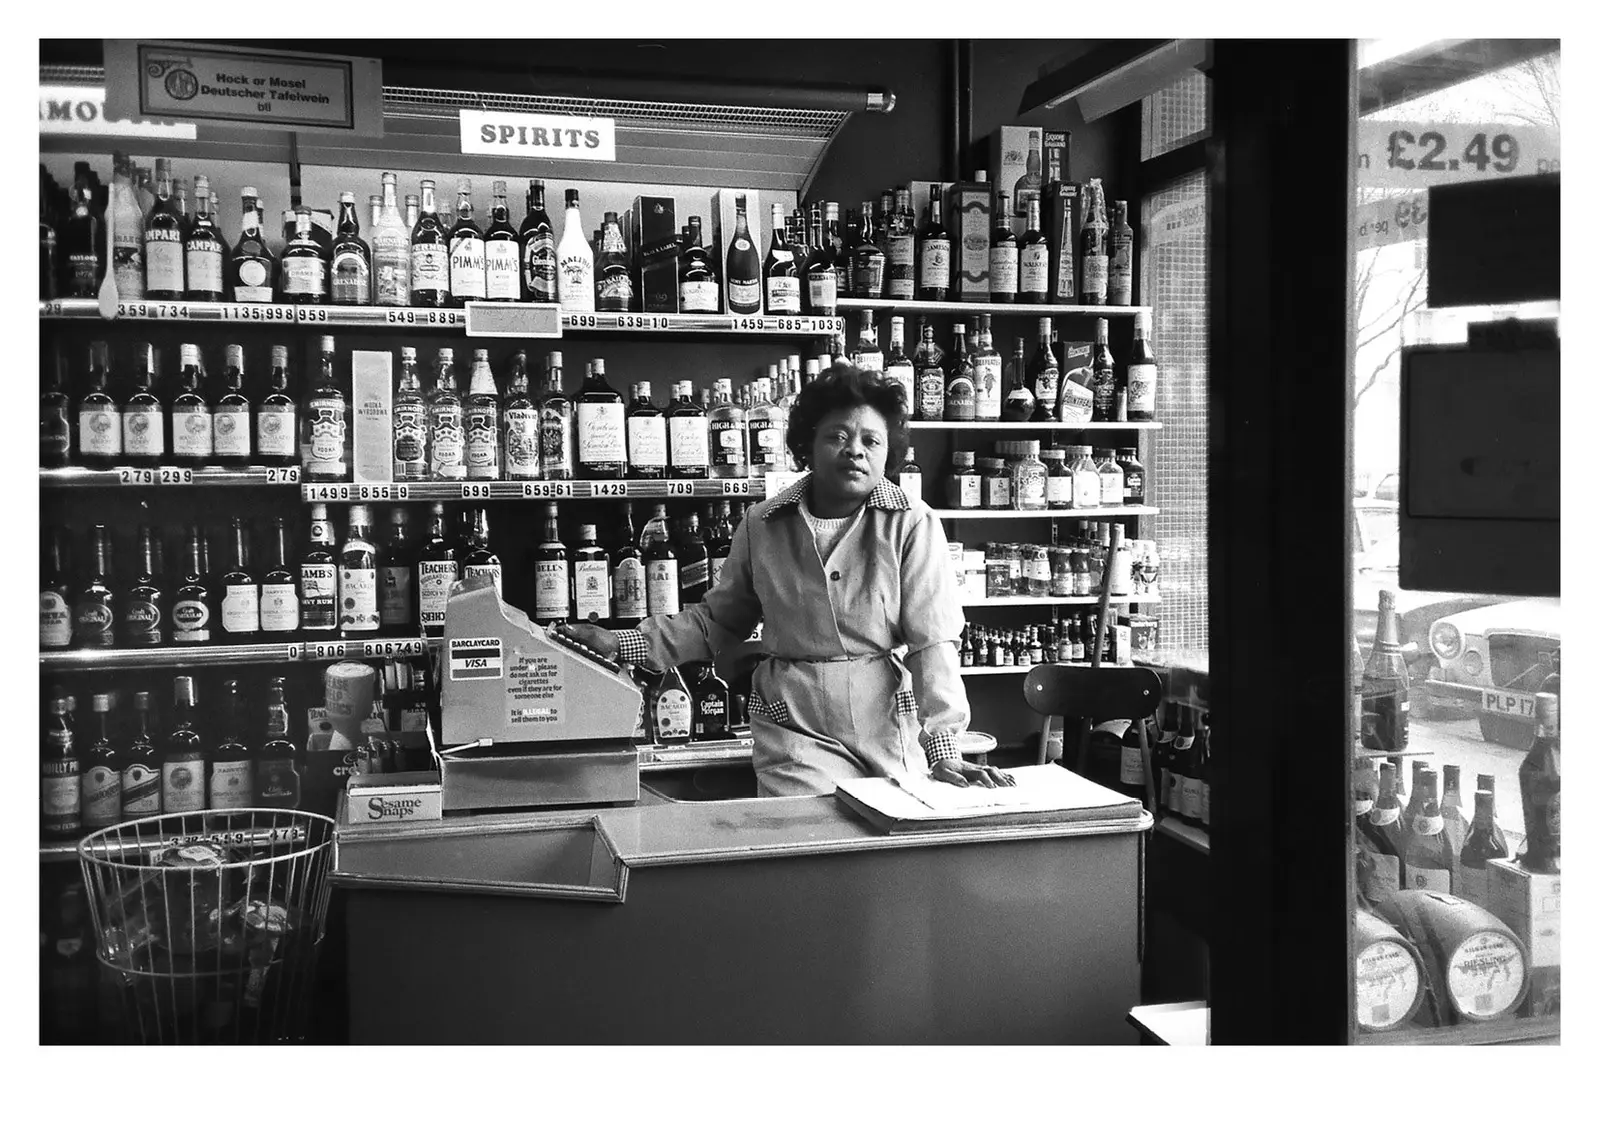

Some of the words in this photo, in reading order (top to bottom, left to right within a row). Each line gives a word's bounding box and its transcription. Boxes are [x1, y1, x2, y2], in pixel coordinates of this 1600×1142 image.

[216, 73, 249, 85] Hock
[252, 77, 266, 86] or
[269, 77, 306, 89] Mosel
[201, 84, 265, 99] Deutscher
[269, 90, 330, 104] Tafelwein
[480, 123, 600, 149] SPIRITS
[1387, 130, 1520, 173] £2.49
[452, 256, 485, 271] PIMM'S
[486, 258, 518, 272] PIMM'S
[119, 304, 147, 316] 359
[159, 305, 189, 317] 734
[222, 307, 260, 319] 1135
[266, 310, 294, 320] 998
[298, 309, 327, 321] 959
[388, 311, 415, 323] 549
[429, 312, 456, 324] 889
[571, 315, 596, 327] 699
[618, 317, 643, 328] 639
[733, 319, 764, 330] 1459
[778, 319, 801, 330] 685
[811, 320, 842, 331] 1039
[121, 471, 152, 483] 279
[162, 471, 192, 483] 299
[268, 469, 297, 482] 279
[310, 487, 349, 500] 1499
[361, 487, 389, 499] 855
[400, 486, 408, 498] 9
[463, 485, 489, 497] 699
[524, 484, 550, 496] 659
[556, 484, 571, 496] 61
[593, 484, 627, 496] 1429
[669, 483, 693, 495] 709
[724, 482, 748, 494] 669
[421, 562, 457, 575] TEACHER'S
[536, 563, 563, 572] BELL'S
[452, 639, 500, 648] BARCLAYCARD
[317, 645, 345, 657] 806
[465, 659, 487, 668] VISA
[510, 664, 528, 672] under
[537, 664, 557, 672] please
[528, 685, 541, 693] they
[1486, 693, 1516, 712] PLP
[546, 715, 558, 723] you
[368, 797, 422, 815] Sesame
[368, 801, 414, 820] Snaps
